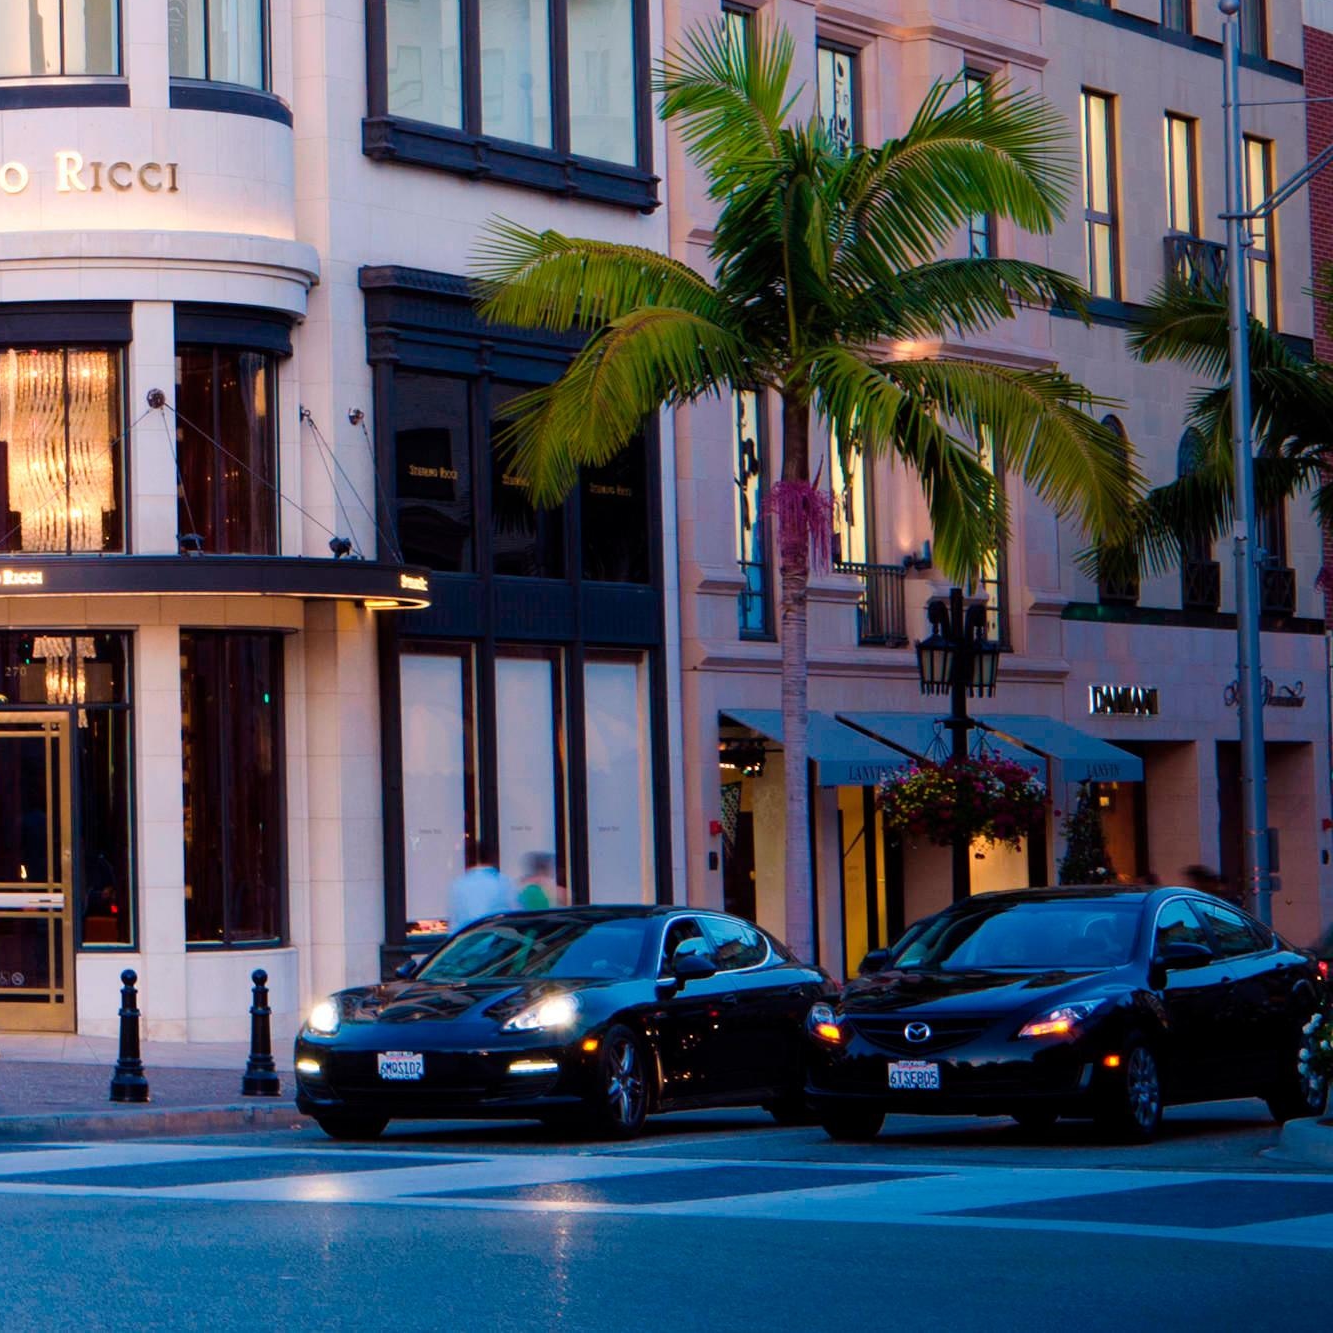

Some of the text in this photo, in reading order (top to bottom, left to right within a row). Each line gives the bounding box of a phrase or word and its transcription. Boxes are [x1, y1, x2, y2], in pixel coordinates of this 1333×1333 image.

[54, 149, 180, 194] RICCI
[2, 569, 44, 585] RICCI
[890, 1070, 938, 1084] 6TSE805
